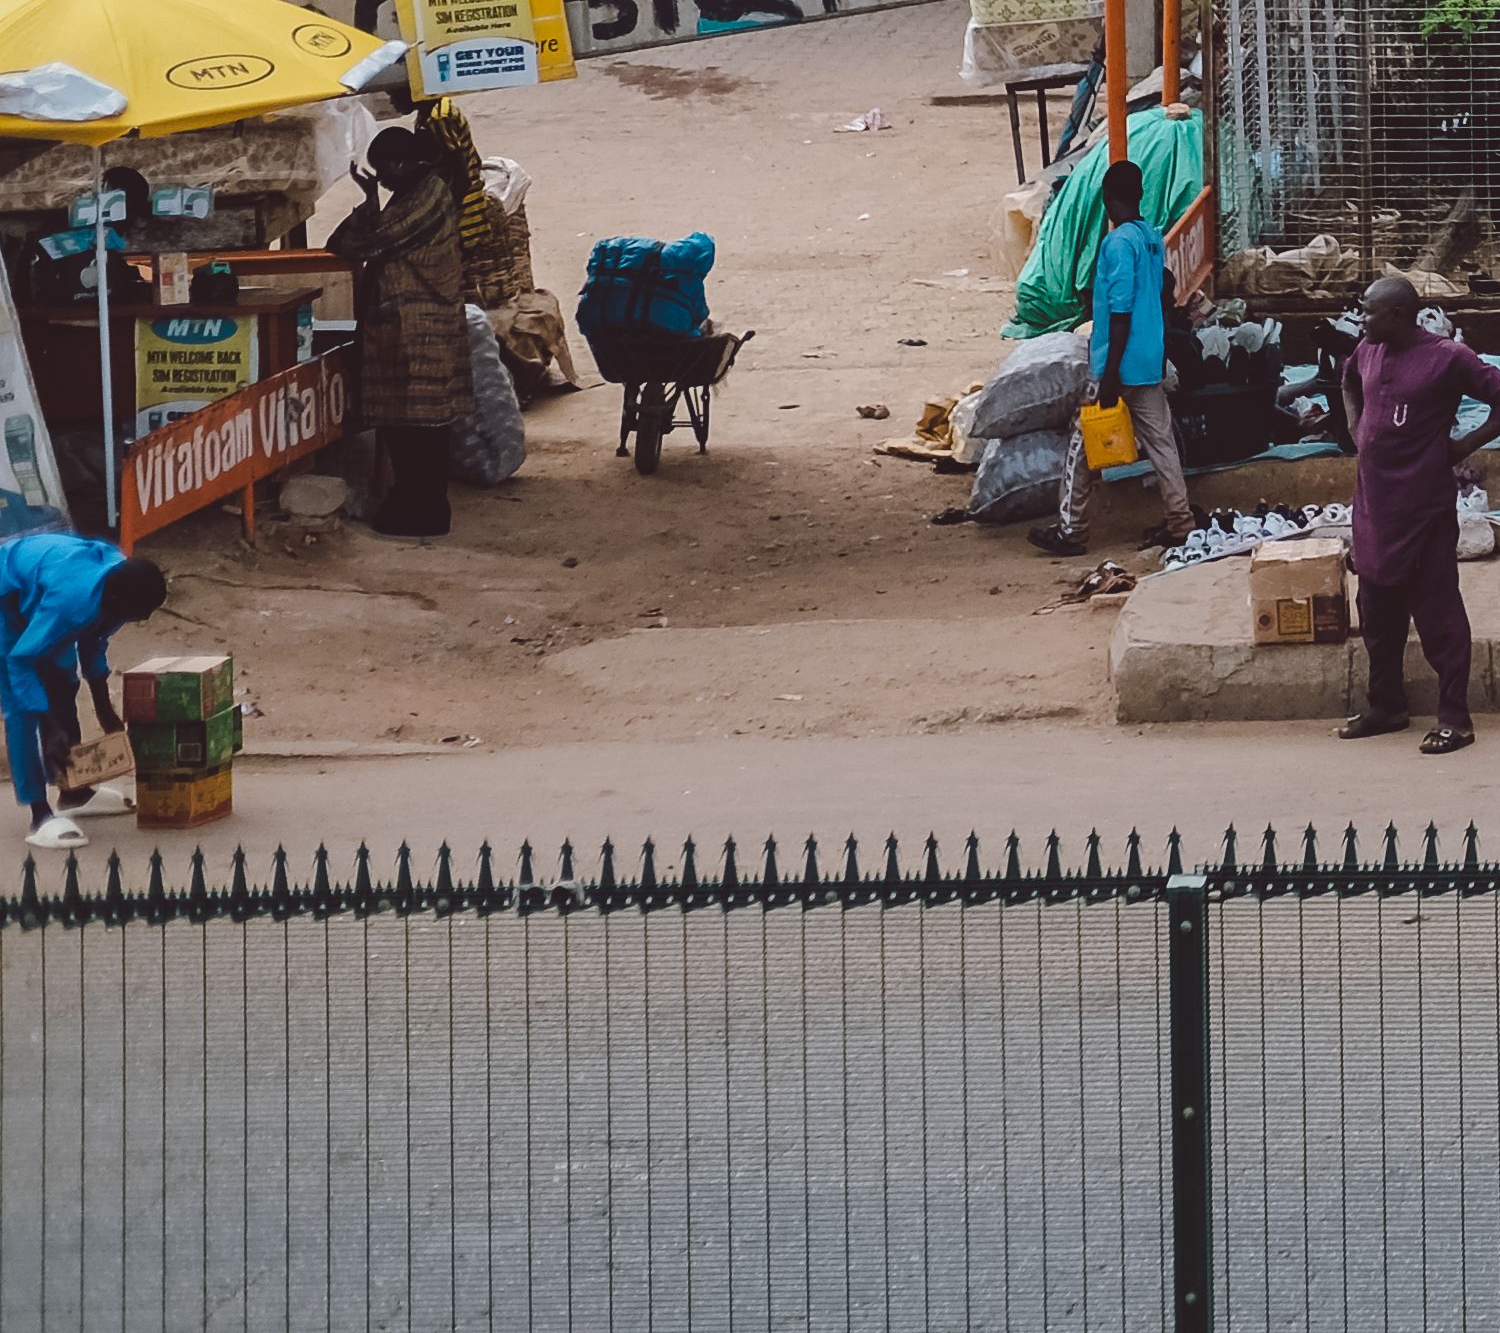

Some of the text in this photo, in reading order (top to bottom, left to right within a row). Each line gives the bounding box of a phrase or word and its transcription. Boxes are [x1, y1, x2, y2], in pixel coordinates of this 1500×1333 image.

[436, 4, 519, 24] SIM REGISTRATION
[308, 31, 337, 51] MTN
[455, 45, 524, 61] GET YOUR
[191, 62, 251, 81] MTN
[166, 319, 223, 337] MTN
[169, 351, 215, 364] WELCOME
[217, 351, 241, 364] BACK
[172, 369, 237, 383] REGISTRATION
[135, 408, 255, 516] Vitafoam
